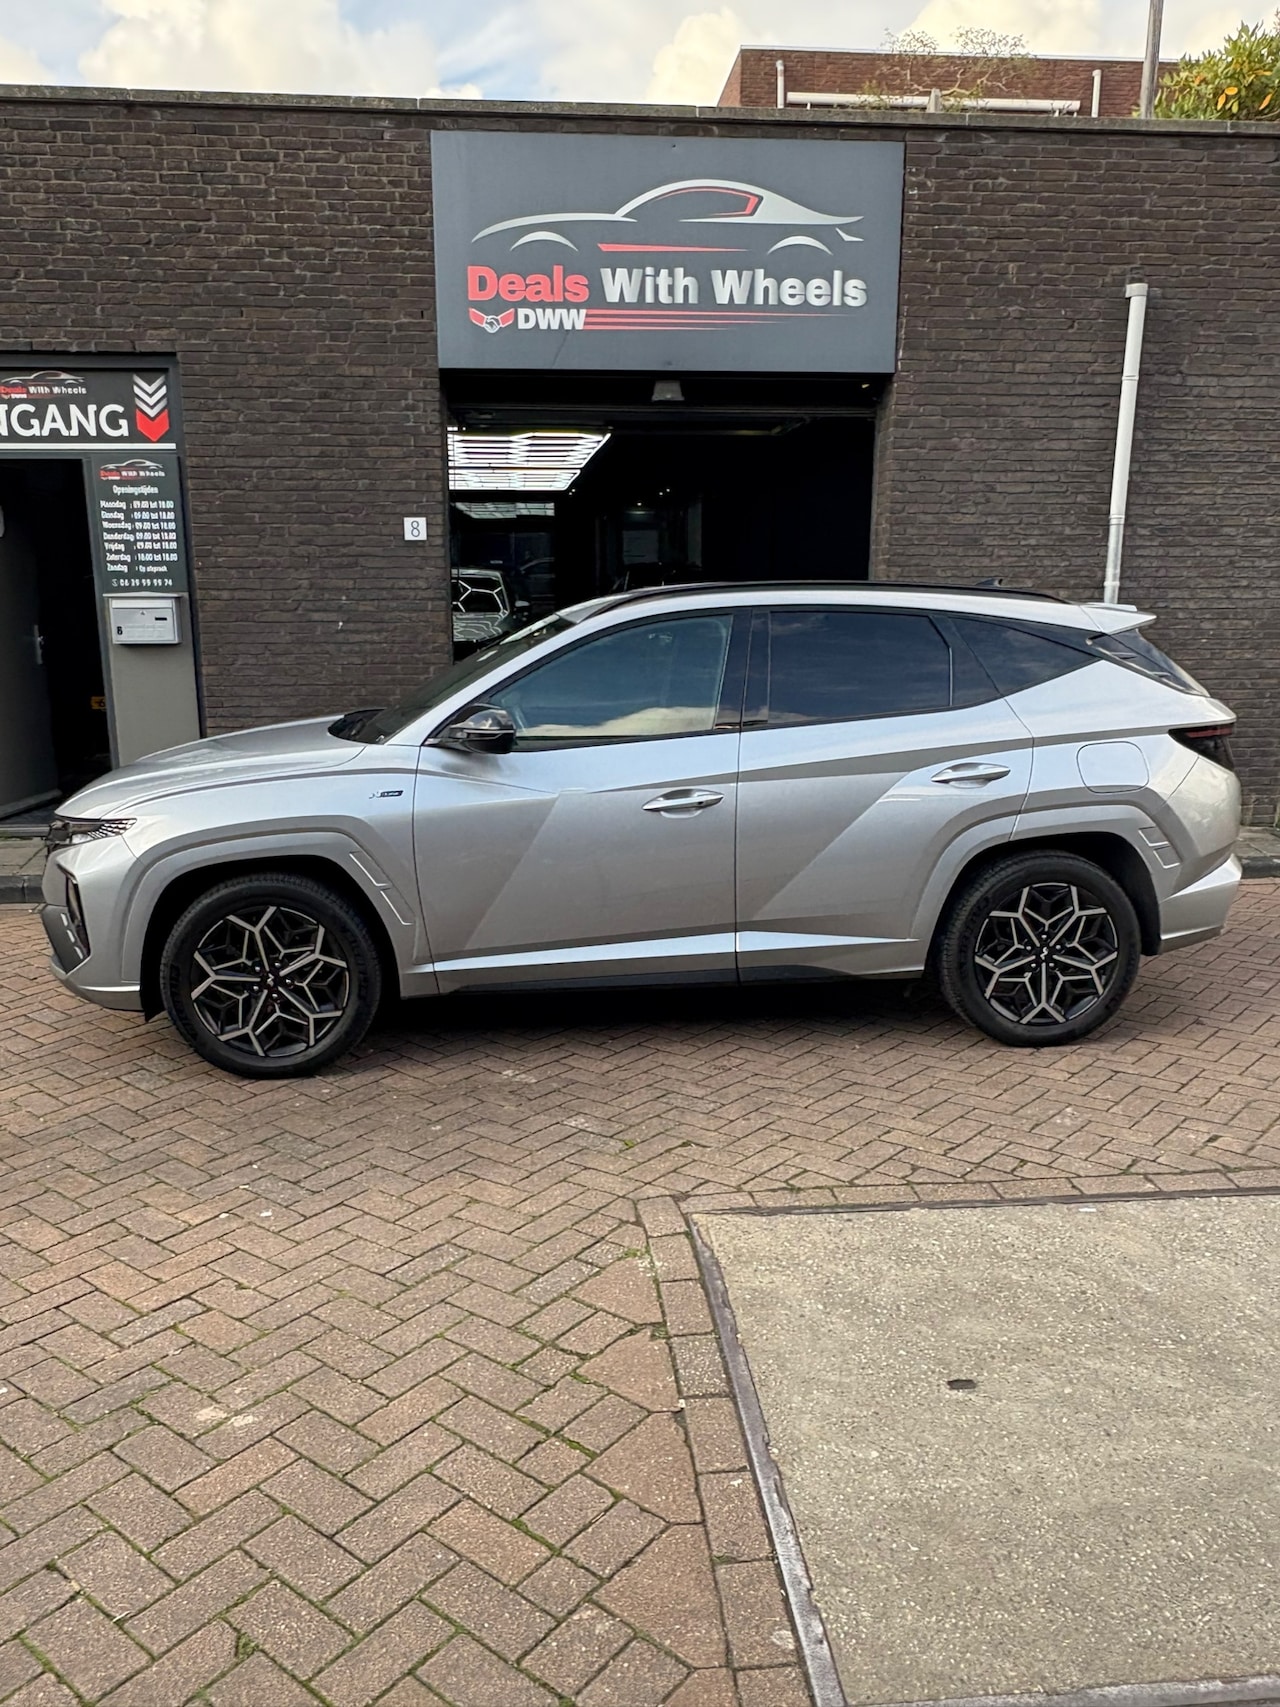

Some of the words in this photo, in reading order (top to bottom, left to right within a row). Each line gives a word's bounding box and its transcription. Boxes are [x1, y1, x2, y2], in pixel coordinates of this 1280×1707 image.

[467, 265, 589, 302] Deals
[600, 267, 699, 304] With
[711, 269, 868, 307] Wheels
[517, 308, 587, 330] DWW
[411, 520, 420, 538] 8
